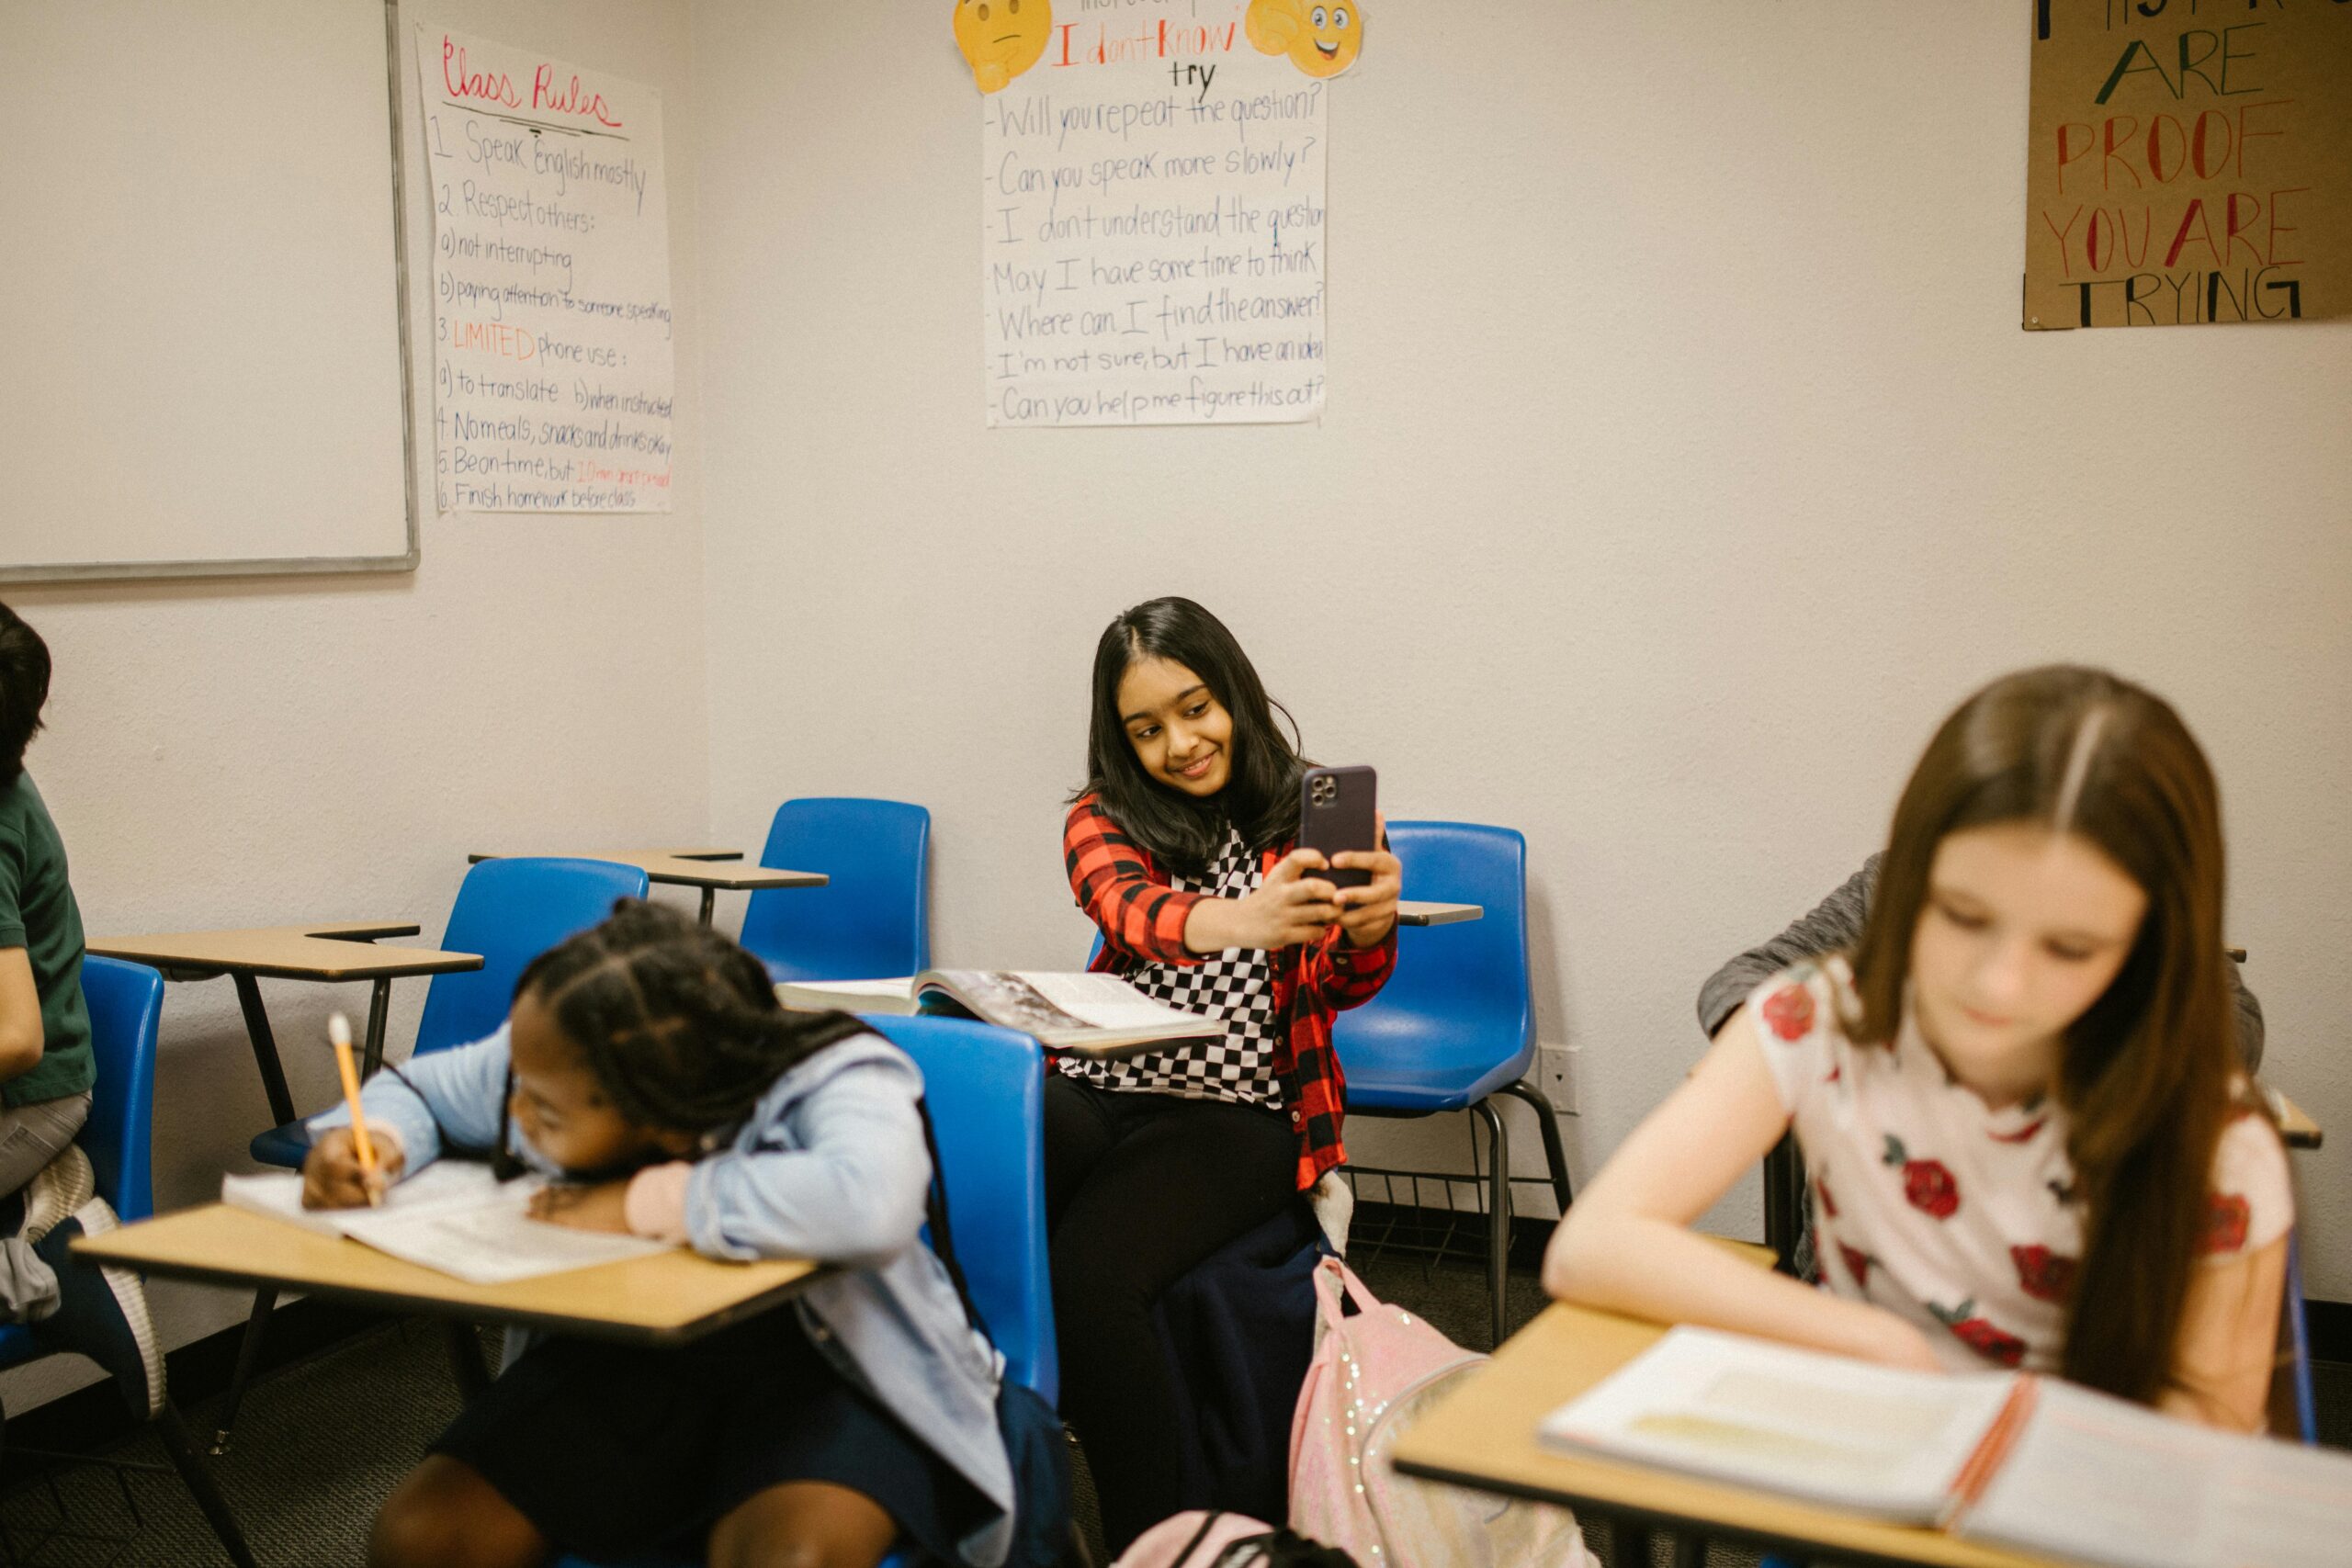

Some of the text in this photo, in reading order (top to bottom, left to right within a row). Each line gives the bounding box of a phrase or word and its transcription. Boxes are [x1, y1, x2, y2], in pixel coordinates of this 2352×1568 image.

[1051, 22, 1080, 66] I
[2094, 22, 2267, 106] ARE
[443, 34, 622, 127] Class Rules
[1168, 62, 1216, 103] try
[998, 95, 1050, 137] Will
[1059, 106, 1091, 152] you
[1096, 96, 1182, 141] repeat
[1186, 96, 1226, 124] the
[1230, 81, 1323, 143] question?
[466, 119, 526, 175] Speak
[534, 139, 590, 196] English
[594, 157, 646, 216] mostly
[2057, 98, 2295, 196] PROOF
[463, 179, 535, 227] Respect
[537, 203, 595, 233] others:
[999, 151, 1046, 195] Can
[1051, 166, 1083, 207] you
[1089, 151, 1158, 197] speak
[1164, 154, 1216, 177] more
[1102, 195, 1220, 239] understand
[1225, 194, 1261, 233] the
[2043, 187, 2311, 278] YOU ARE
[459, 233, 481, 257] not
[485, 238, 572, 293] interrupting
[993, 241, 1317, 308] May I have some time to think
[458, 281, 502, 321] paying
[503, 283, 559, 308] attention
[998, 304, 1073, 341] Where
[1080, 310, 1116, 336] can
[1122, 299, 1149, 334] I
[1156, 290, 1214, 342] find
[1216, 287, 1249, 322] the
[2059, 265, 2301, 328] TRYING
[455, 320, 536, 361] LIMITED
[538, 332, 582, 367] phone
[1053, 349, 1090, 372] not
[1098, 352, 1148, 371] sure,
[1151, 343, 1191, 370] but
[1195, 337, 1217, 367] I
[1222, 337, 1273, 363] have
[1275, 341, 1295, 361] an
[457, 369, 474, 395] to
[479, 374, 559, 403] translate
[1002, 386, 1048, 420] Can
[1055, 396, 1091, 423] you
[1097, 389, 1148, 423] help
[1152, 393, 1182, 407] me
[1185, 375, 1246, 419] figure
[1249, 380, 1284, 407] this
[455, 412, 479, 441] No
[481, 415, 536, 446] meals,
[584, 419, 607, 450] and
[455, 446, 478, 474] Be
[479, 457, 499, 475] on
[501, 448, 548, 479] time,
[549, 457, 574, 481] but
[456, 482, 502, 508] Finish
